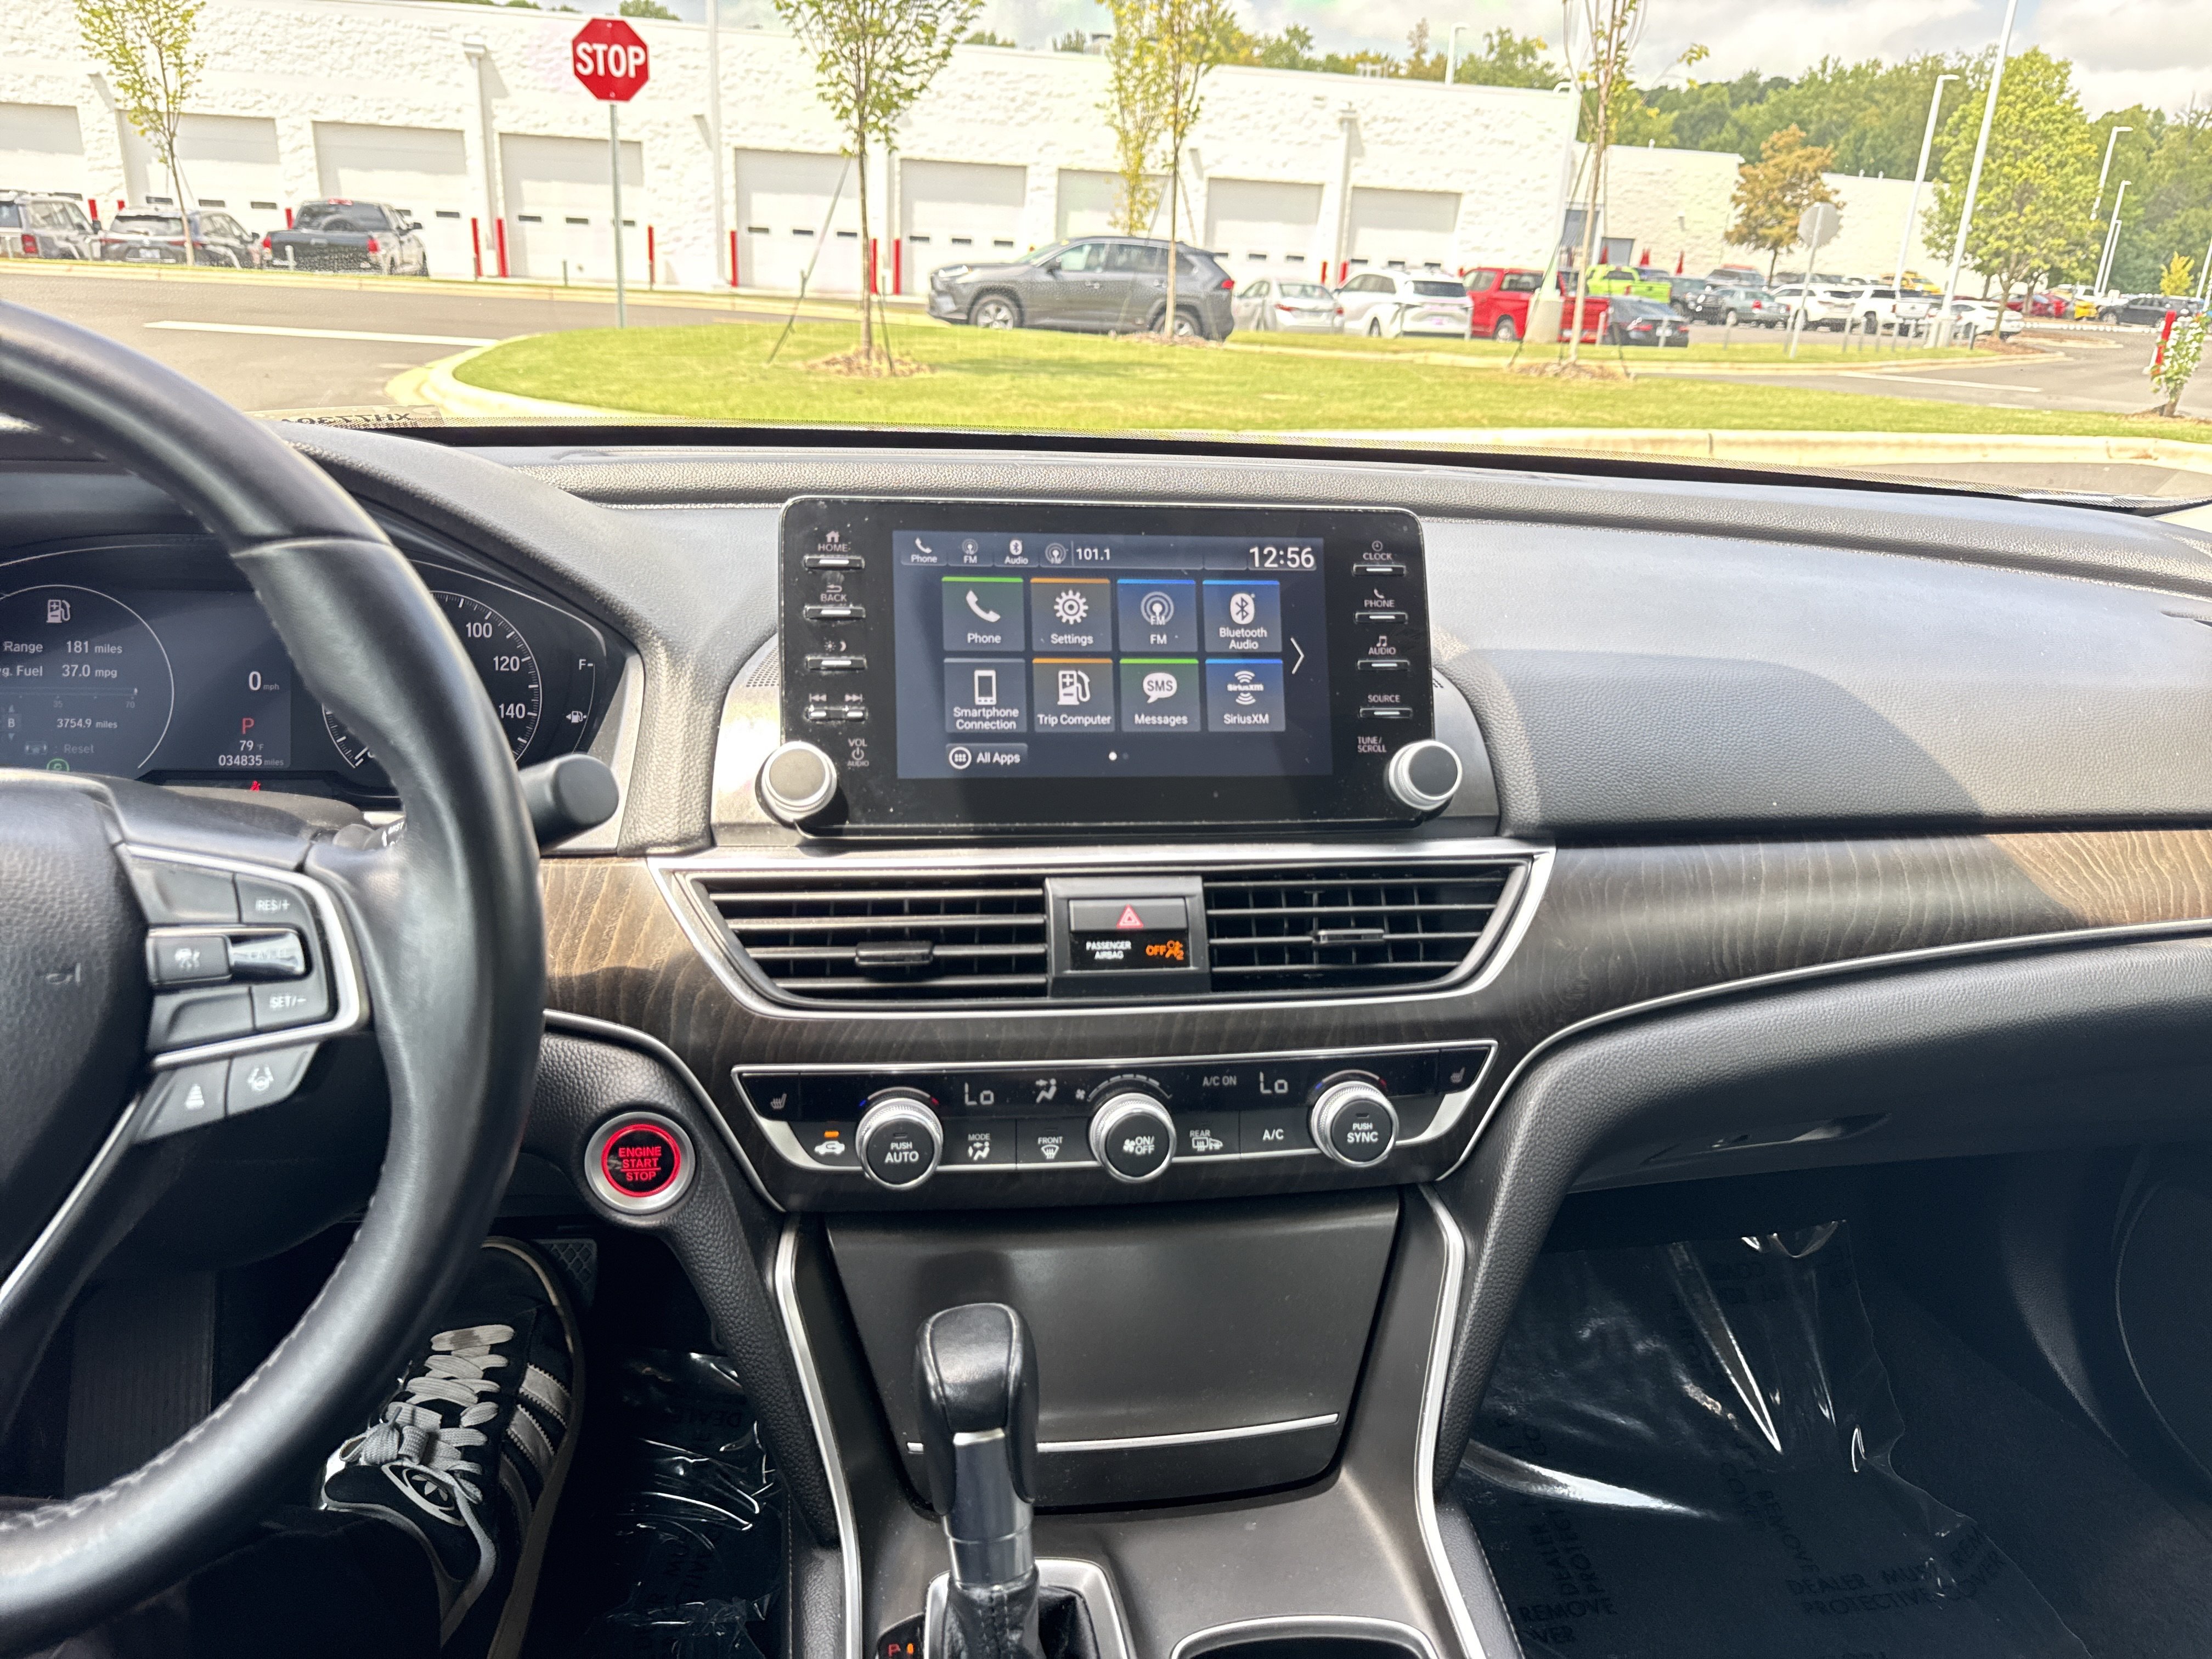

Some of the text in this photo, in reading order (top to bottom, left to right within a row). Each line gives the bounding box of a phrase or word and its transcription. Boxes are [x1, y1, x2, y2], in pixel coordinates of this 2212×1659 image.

[575, 42, 646, 78] STOP
[817, 543, 848, 552] HOME
[911, 554, 938, 563] Phone
[1076, 548, 1110, 561] 101.1
[1249, 546, 1315, 568] 12:56
[1363, 552, 1393, 560] CLOCK
[1004, 556, 1029, 565] Audio
[820, 594, 848, 602] BACK
[1364, 599, 1395, 608] PHONE
[466, 622, 493, 637] 100
[1219, 627, 1267, 638] Bluetooth
[967, 633, 1002, 644] Phone
[1050, 633, 1093, 645] Settings
[1150, 634, 1167, 645] FM
[3, 640, 123, 653] Range 181 miles
[1229, 640, 1259, 650] Audio
[1368, 647, 1396, 655] AUDIO
[494, 656, 520, 672] 120
[579, 659, 586, 670] F
[16, 665, 43, 676] Fuel
[62, 664, 91, 677] 37.0
[95, 669, 117, 678] mpg
[249, 671, 262, 691] 0
[1147, 680, 1173, 692] SMS
[1368, 695, 1401, 703] SOURCE
[126, 701, 136, 709] 70
[499, 703, 526, 719] 140
[953, 707, 1019, 718] Smartphone
[7, 718, 118, 729] B 3754.9 miles
[956, 719, 1017, 730] Connection
[1037, 714, 1111, 727] Trip Computer
[1134, 713, 1188, 727] Messages
[1223, 713, 1269, 725] SiriusXM
[241, 717, 255, 734] P
[239, 740, 254, 751] 79
[848, 738, 868, 747] VOL
[1357, 736, 1383, 744] TUNE/
[64, 743, 94, 754] Reset
[1357, 744, 1386, 753] SCROLL
[218, 754, 284, 766] 034835 miles
[977, 752, 1020, 765] All Apps
[1086, 940, 1132, 951] PASSENGER
[1146, 944, 1167, 956] OFF
[1094, 950, 1124, 960] AIRBAG
[1203, 1075, 1237, 1087] A/C ON
[1260, 1071, 1288, 1093] Lo
[964, 1082, 995, 1105] Lo
[1352, 1122, 1373, 1131] PUSH
[968, 1133, 990, 1141] MODE
[1037, 1136, 1063, 1144] FRONT
[1262, 1128, 1284, 1141] A/C
[1347, 1131, 1379, 1143] SYNC
[890, 1141, 912, 1150] PUSH
[1135, 1135, 1155, 1146] ON/
[618, 1146, 662, 1158] ENGINE
[1135, 1145, 1155, 1155] OFF
[623, 1157, 659, 1169] START
[884, 1151, 919, 1164] AUTO
[626, 1171, 657, 1182] STOP
[1785, 1572, 1872, 1596] DEALER
[1517, 1597, 1618, 1623] REMOVE
[888, 1643, 901, 1657] P
